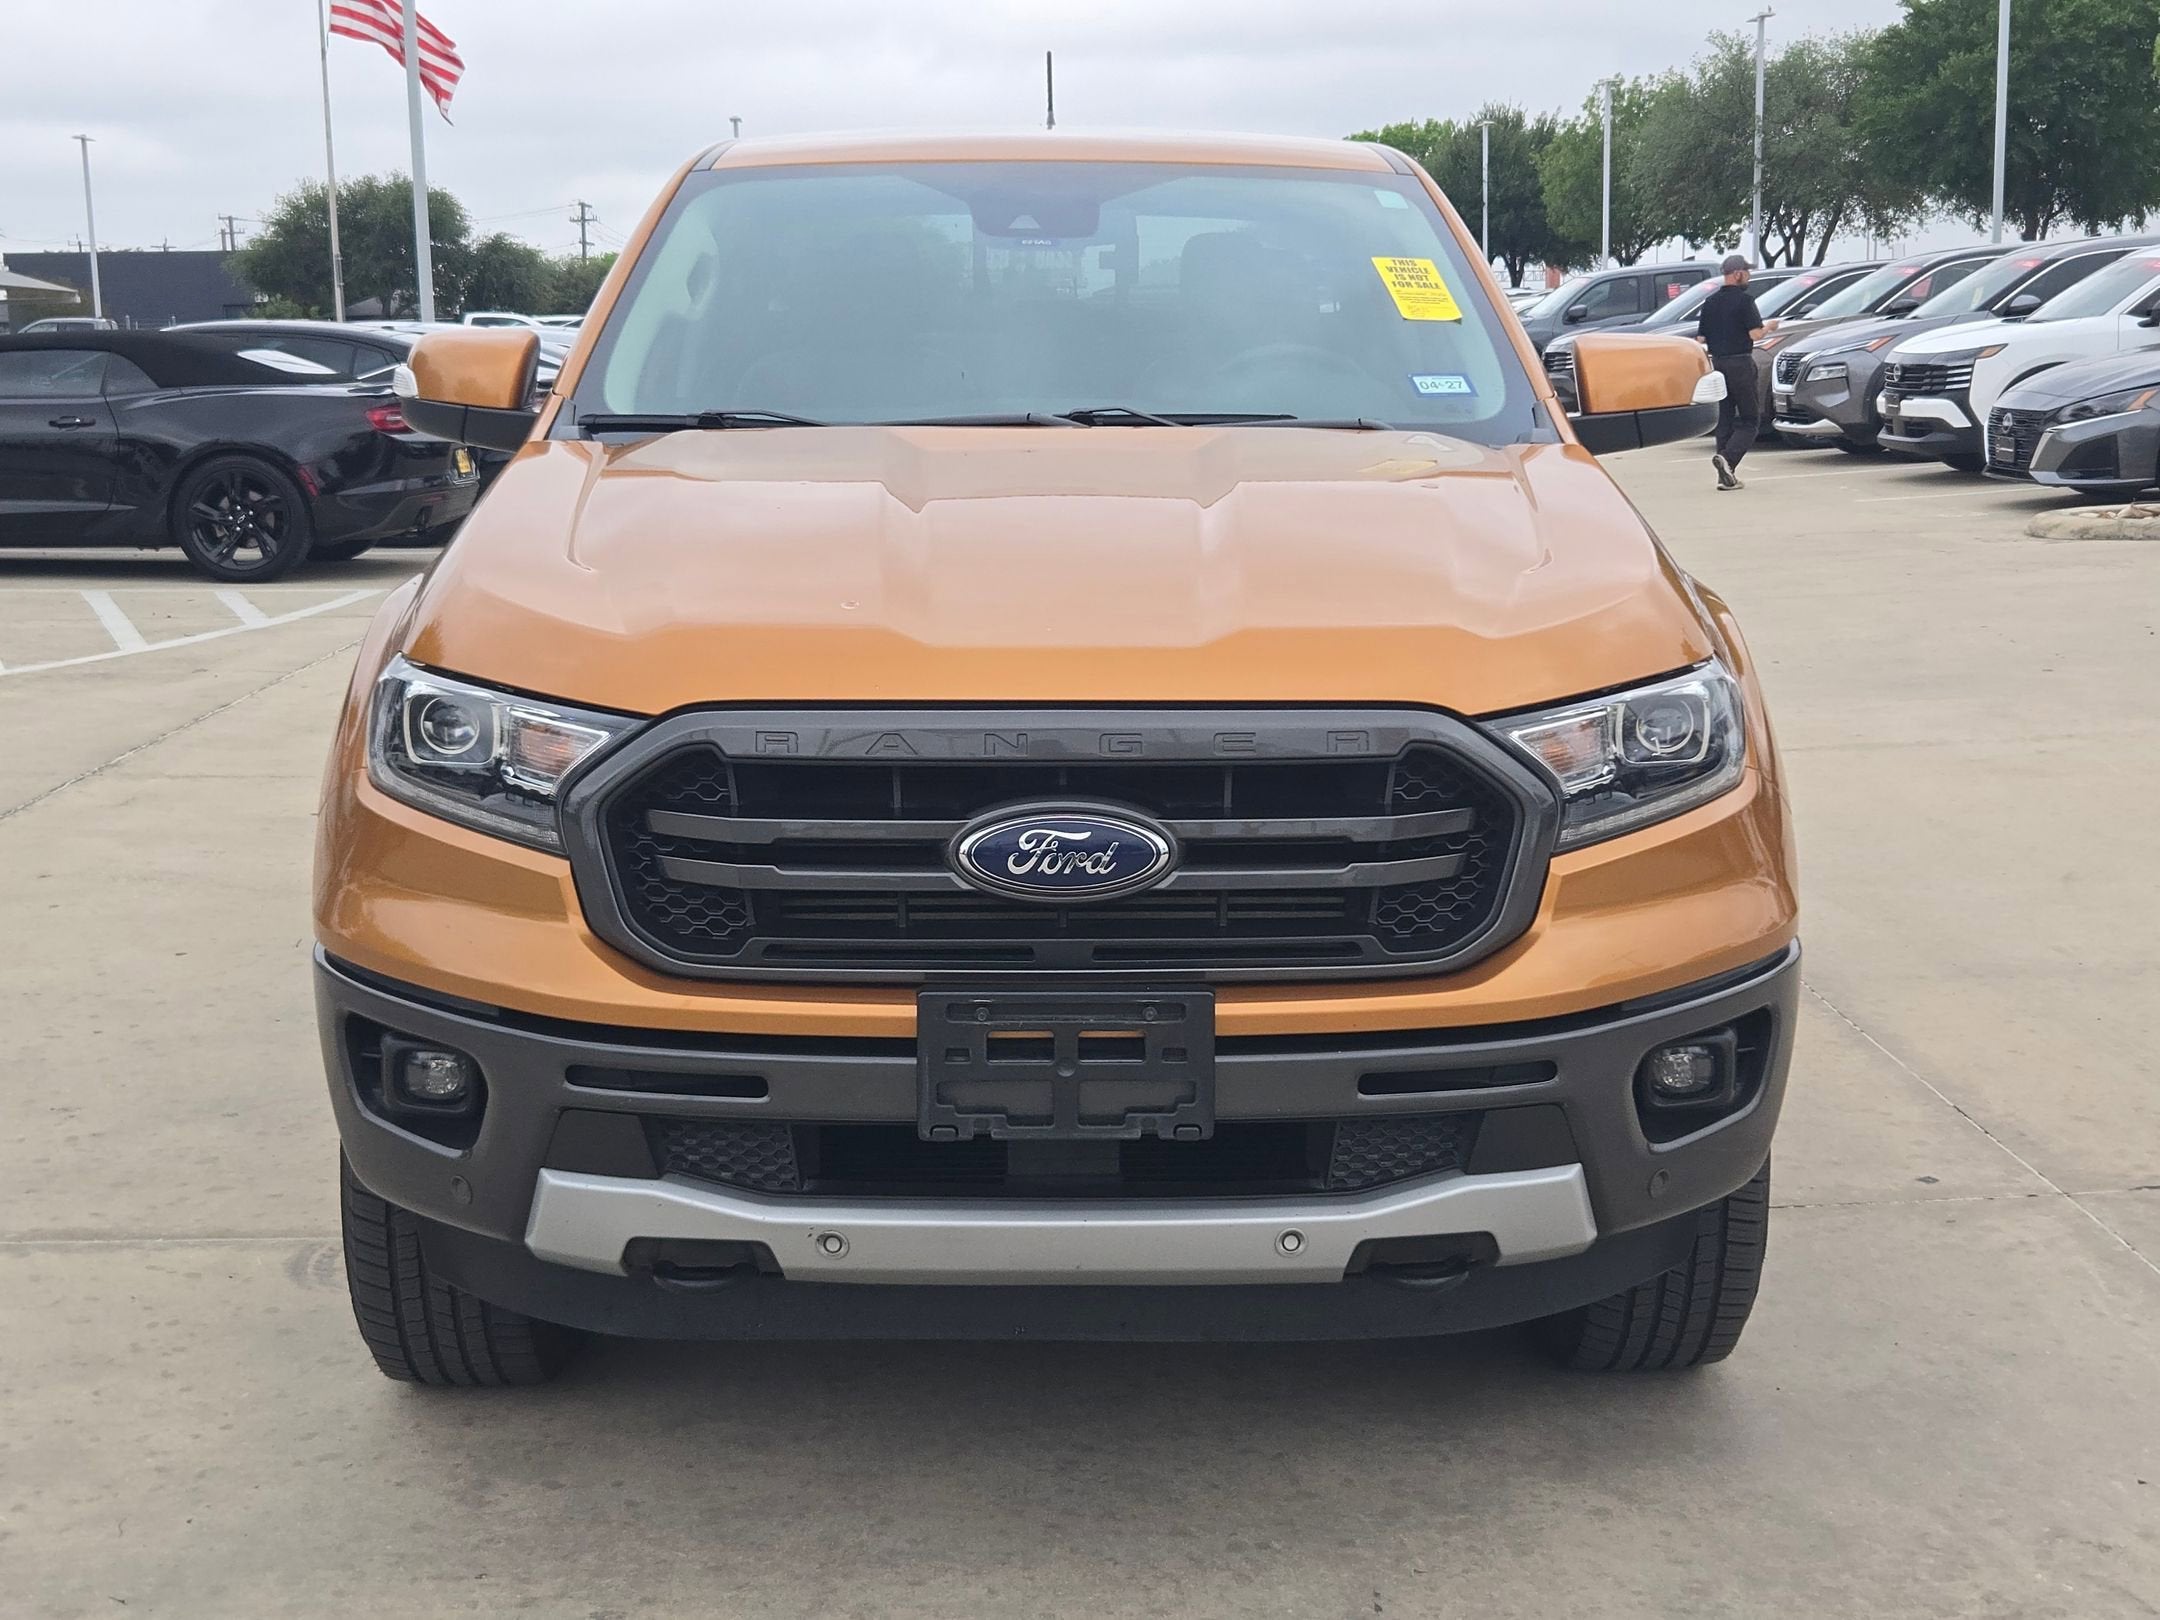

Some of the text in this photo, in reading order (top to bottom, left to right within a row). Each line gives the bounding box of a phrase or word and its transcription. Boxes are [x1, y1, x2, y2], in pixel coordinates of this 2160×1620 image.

[1385, 266, 1431, 274] VEHICLE
[754, 729, 1371, 758] RANGER
[1007, 828, 1119, 876] Ford
